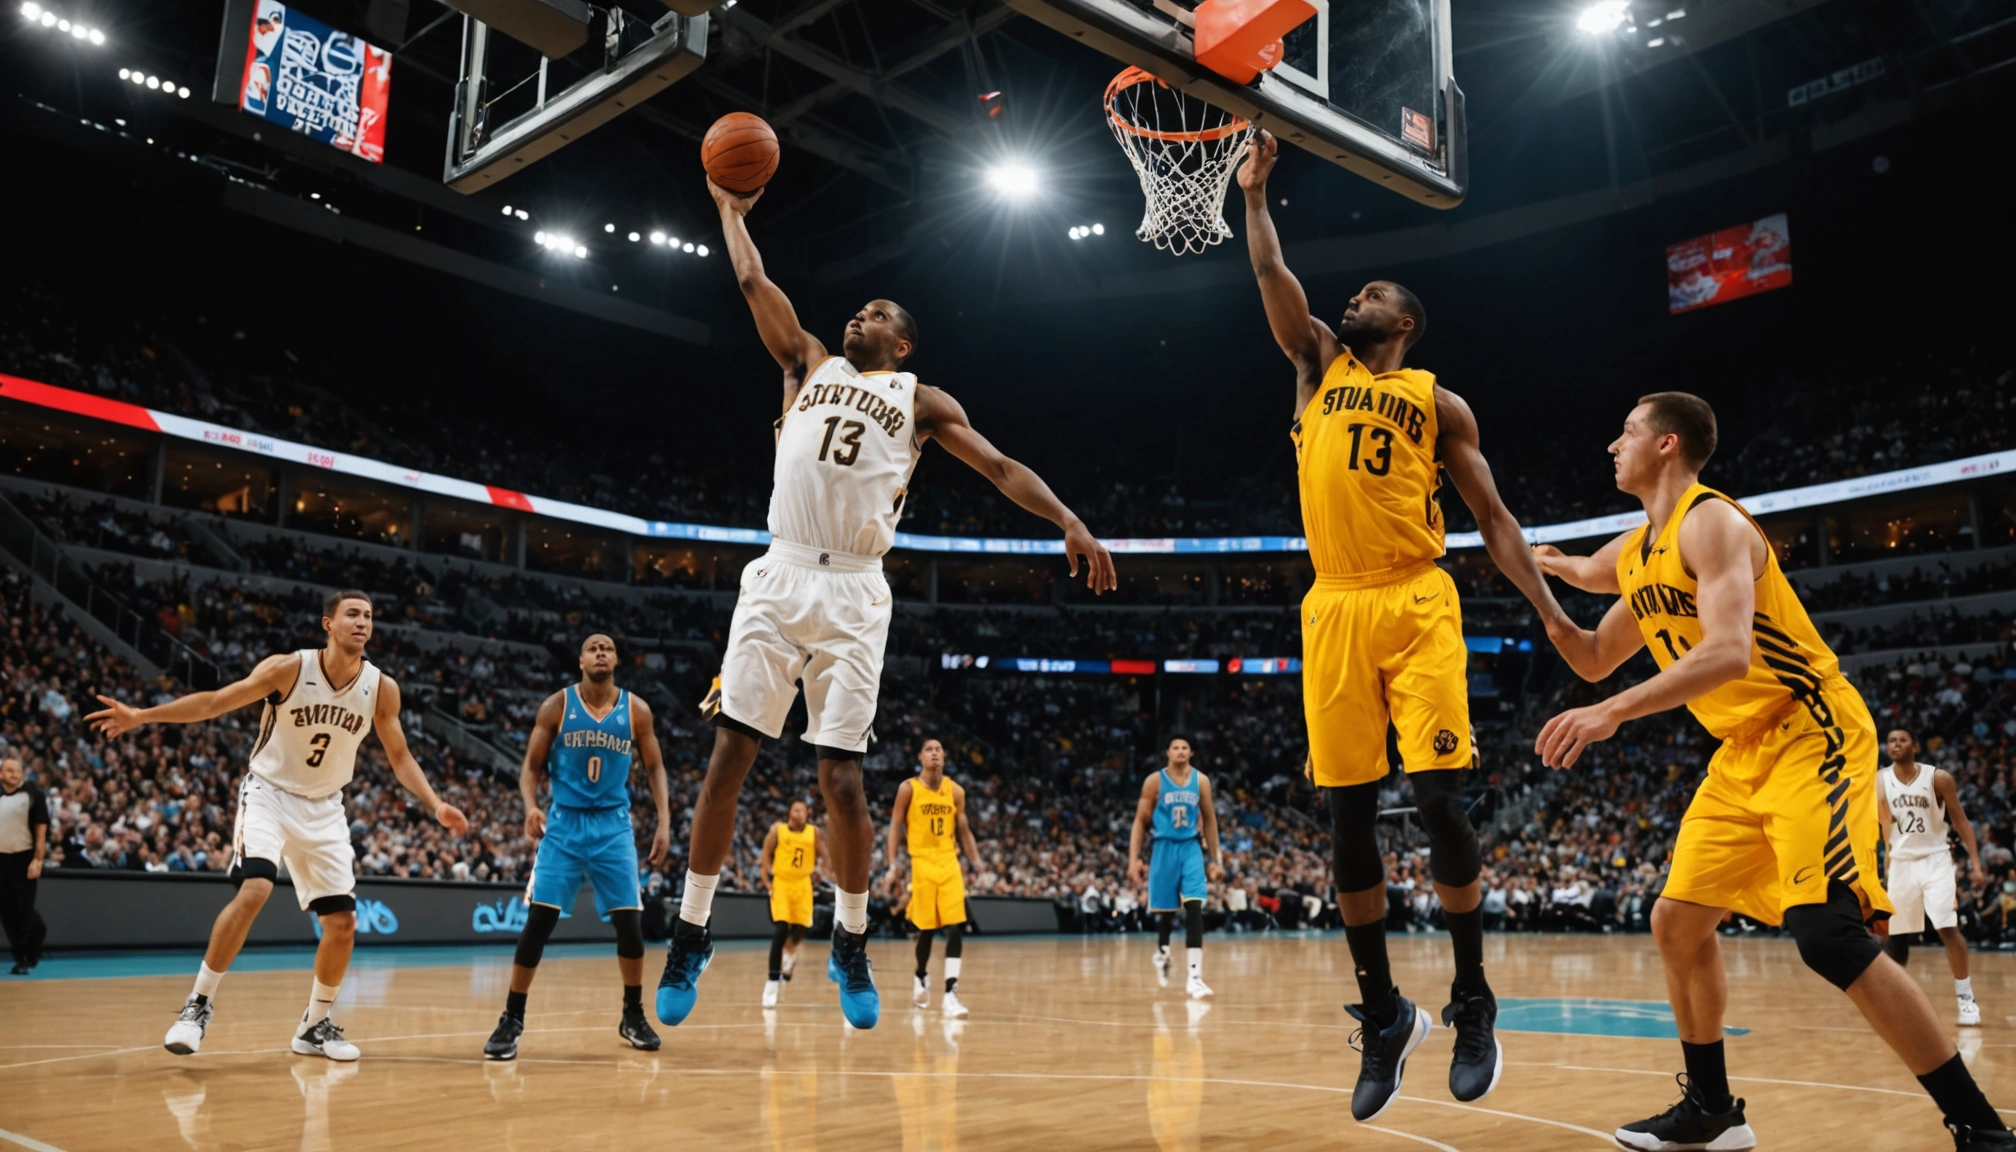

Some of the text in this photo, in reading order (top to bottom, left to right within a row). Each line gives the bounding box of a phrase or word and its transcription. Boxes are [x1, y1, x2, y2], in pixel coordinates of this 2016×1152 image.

[818, 416, 865, 466] 13
[1348, 423, 1394, 477] 13
[587, 756, 602, 783] 0
